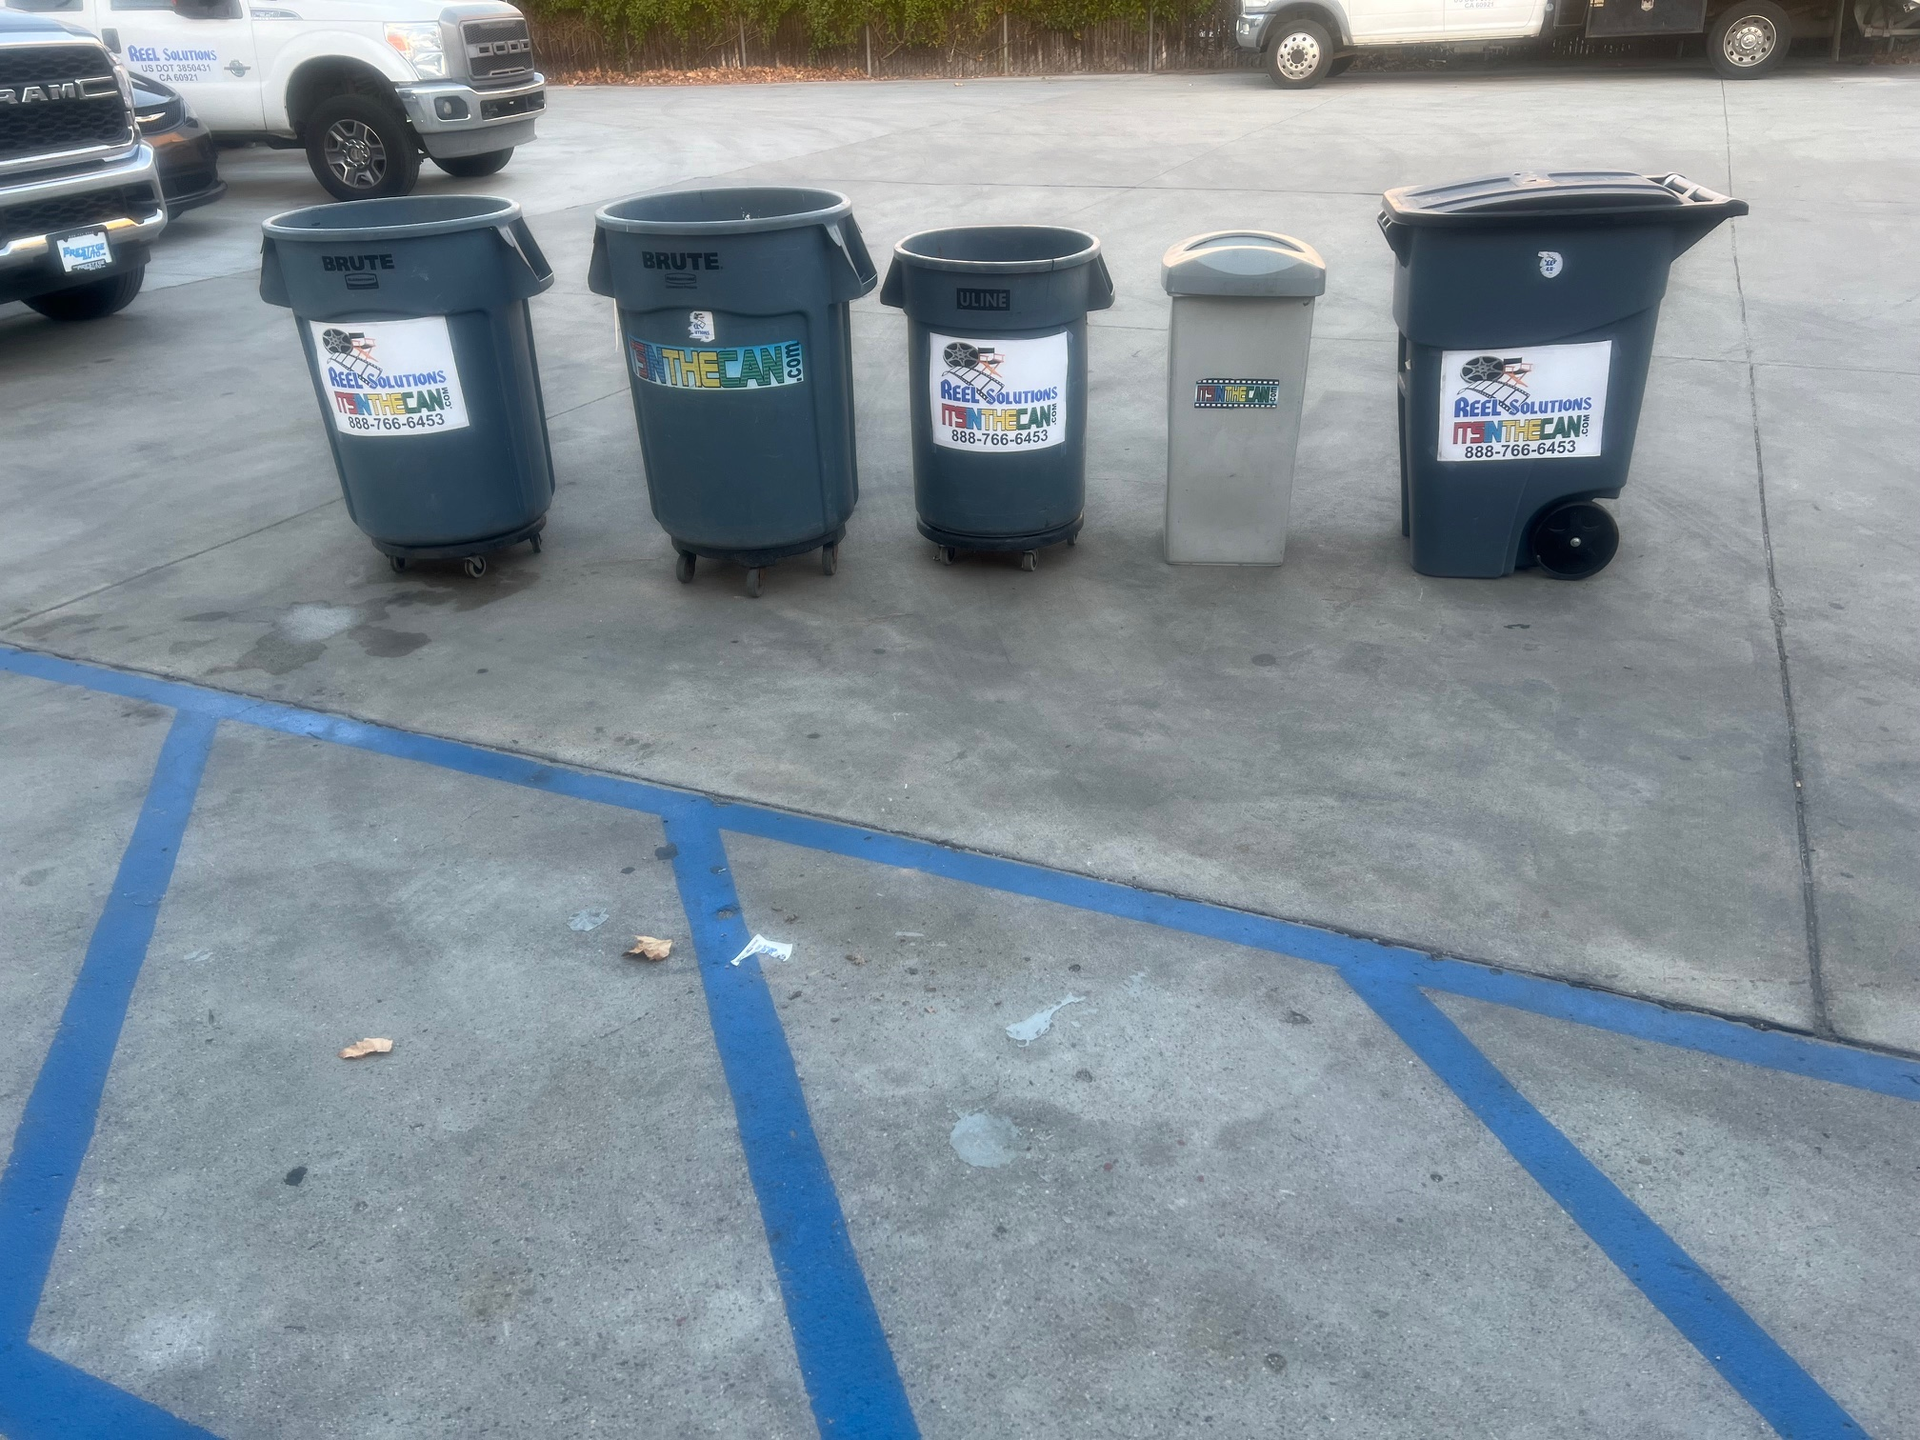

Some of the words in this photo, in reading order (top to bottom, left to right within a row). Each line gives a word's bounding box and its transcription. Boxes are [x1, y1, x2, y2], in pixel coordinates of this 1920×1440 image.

[141, 64, 154, 73] US
[156, 64, 174, 73] DOT
[176, 64, 211, 73] 3850431
[159, 73, 173, 82] CA
[174, 73, 198, 82] 60921
[0, 83, 76, 104] RAM
[321, 253, 395, 272] BRUTE
[641, 251, 720, 271] BRUTE
[959, 291, 1007, 308] ULINE
[348, 413, 445, 430] 888-766-6453
[951, 429, 1048, 446] 888-766-6453
[1464, 440, 1576, 459] 888-766-6453
